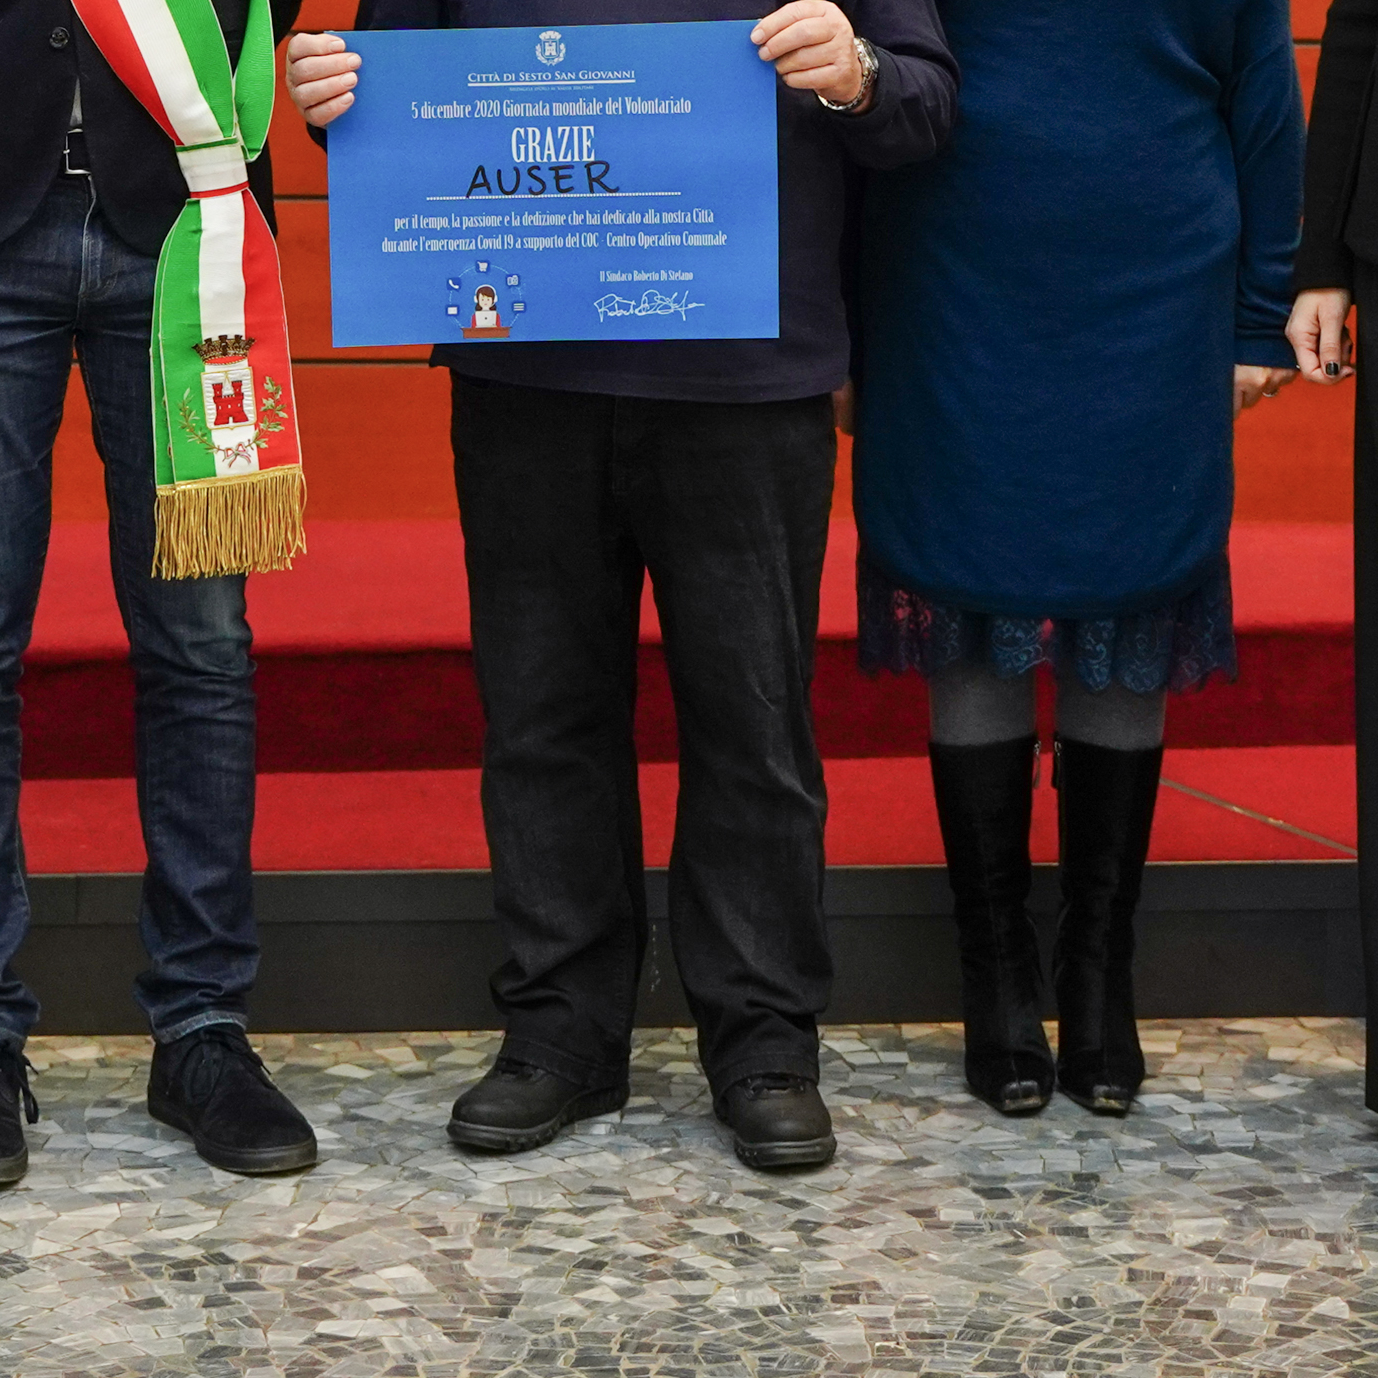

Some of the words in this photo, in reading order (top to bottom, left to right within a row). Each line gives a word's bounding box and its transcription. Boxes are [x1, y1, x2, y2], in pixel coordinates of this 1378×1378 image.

[411, 102, 419, 120] 5
[421, 100, 472, 119] dicembre
[474, 99, 501, 118] 2020
[503, 98, 550, 118] Giornata
[552, 97, 604, 116] mondiale
[605, 96, 623, 116] del
[624, 96, 692, 114] Volontariato
[511, 126, 596, 163] GRAZIE
[466, 160, 620, 198] AUSER
[394, 216, 411, 232] per
[412, 214, 418, 230] il
[420, 214, 450, 231] tempo,
[452, 213, 461, 228] la
[462, 212, 502, 230] passione
[504, 216, 510, 227] e
[512, 212, 521, 227] la
[522, 210, 566, 226] dedizione
[568, 210, 585, 226] che
[586, 210, 601, 225] hai
[602, 209, 642, 225] dedicato
[643, 208, 660, 224] alla
[662, 209, 691, 224] nostra
[692, 208, 714, 223] Città
[382, 237, 418, 253] durante
[477, 234, 502, 250] Covid
[504, 234, 514, 250] 19
[516, 238, 522, 249] a
[523, 234, 564, 250] supporto
[566, 232, 580, 248] del
[581, 232, 599, 248] COC
[606, 232, 636, 247] Centro
[637, 231, 680, 249] Operativo
[682, 230, 728, 246] Comunale
[606, 270, 632, 282] Sindaco
[633, 270, 659, 282] Roberto
[660, 270, 668, 282] Di
[668, 270, 694, 281] Stefano
